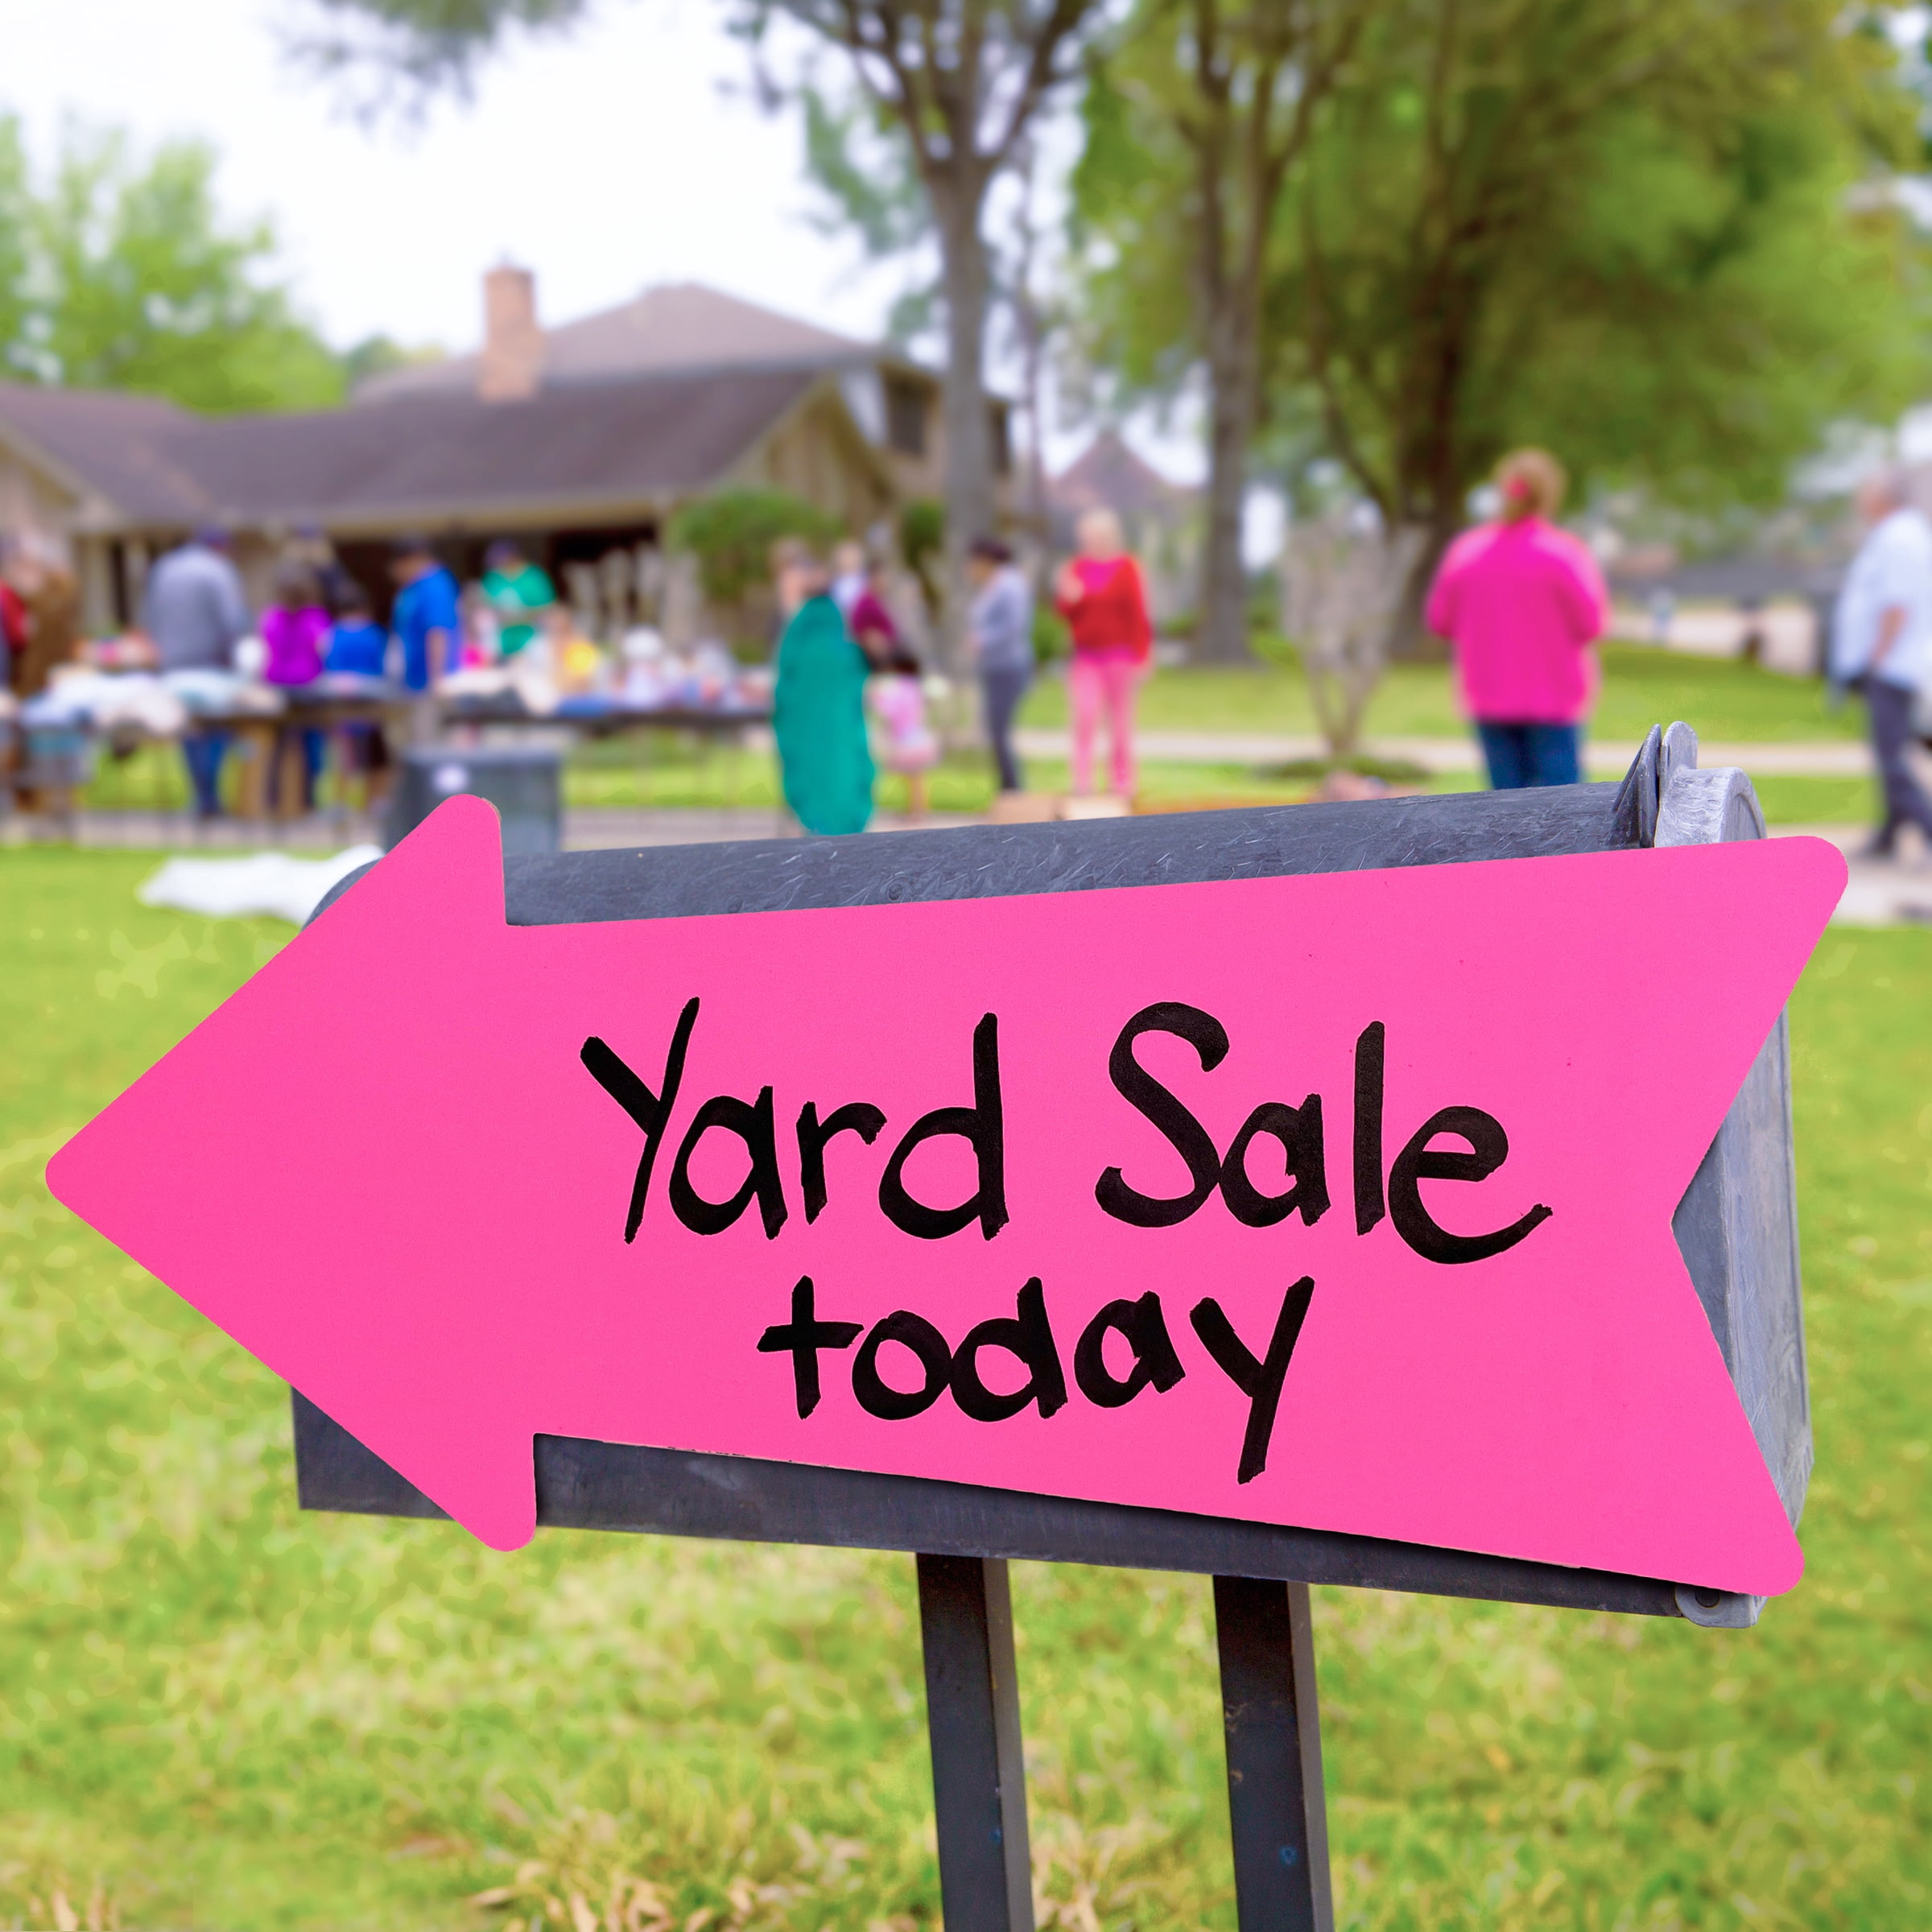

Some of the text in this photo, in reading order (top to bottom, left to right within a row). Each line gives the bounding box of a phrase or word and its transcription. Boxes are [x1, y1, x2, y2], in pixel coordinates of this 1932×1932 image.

[580, 997, 1553, 1265] Yard Sale
[756, 1275, 1315, 1485] today
